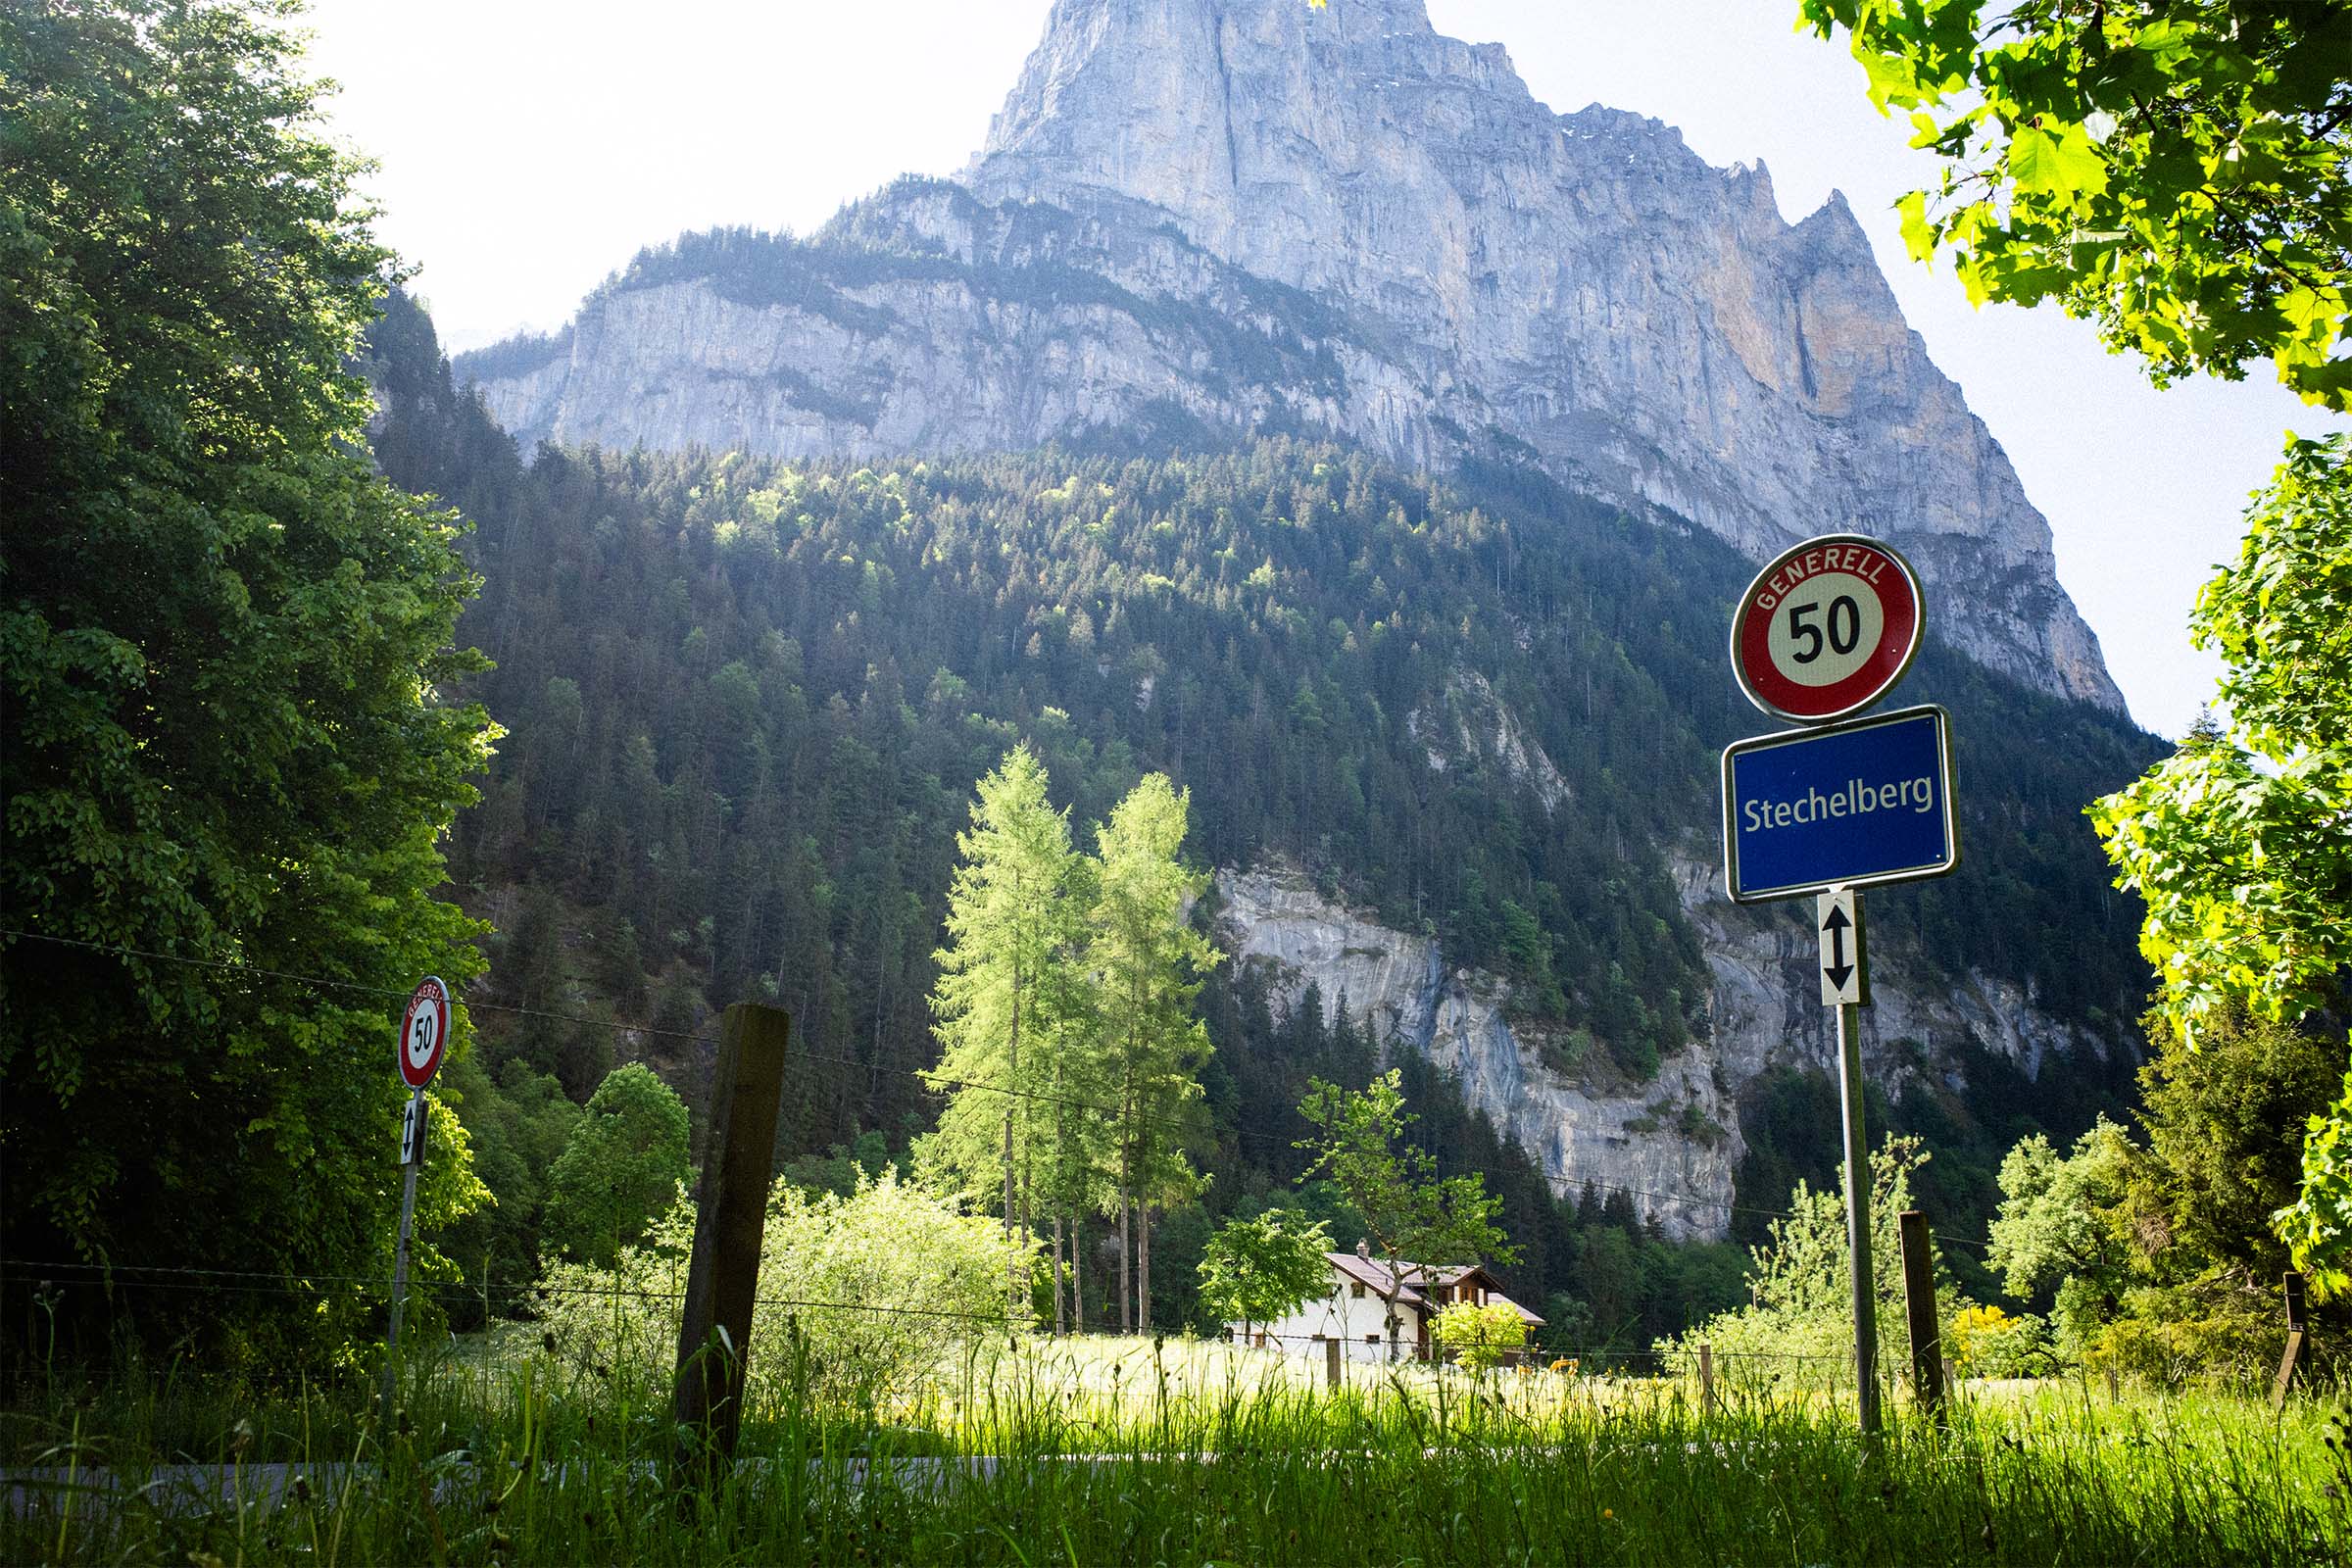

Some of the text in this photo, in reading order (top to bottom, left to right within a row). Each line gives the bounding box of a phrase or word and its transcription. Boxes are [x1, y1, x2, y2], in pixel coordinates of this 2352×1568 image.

[1756, 548, 1886, 611] GENERELL
[1788, 595, 1860, 663] 50
[1744, 776, 1934, 832] Stechelberg
[415, 1014, 433, 1053] 50
